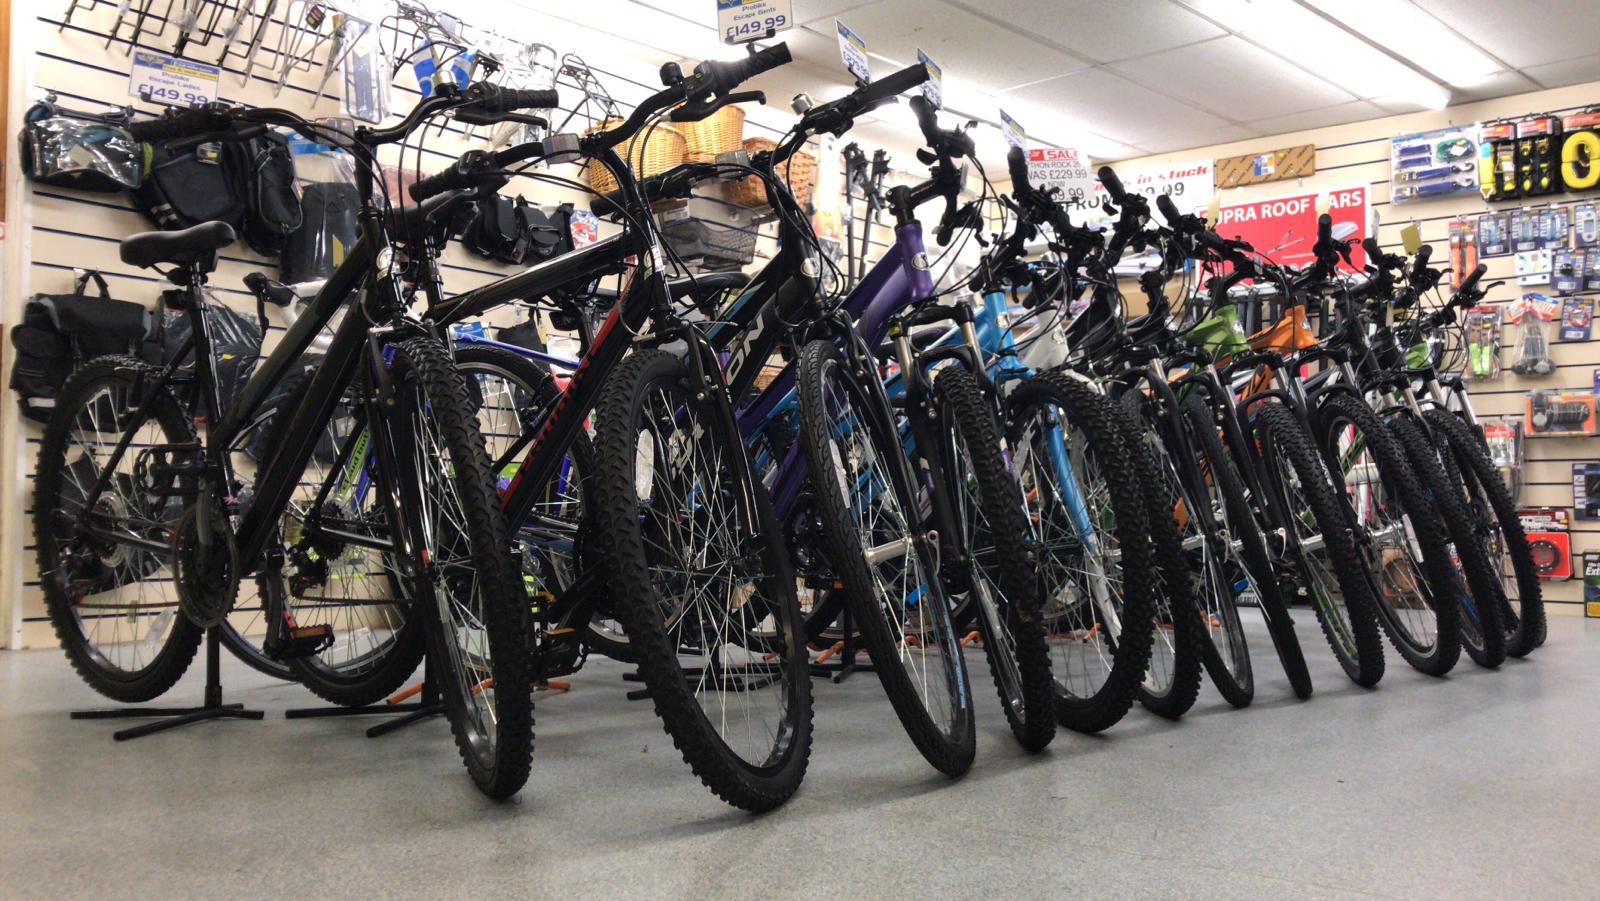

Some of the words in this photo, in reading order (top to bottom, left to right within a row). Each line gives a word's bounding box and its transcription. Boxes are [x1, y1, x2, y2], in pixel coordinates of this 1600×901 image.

[758, 7, 776, 15] Gents
[727, 15, 786, 37] £149.99
[177, 81, 202, 91] Ladies
[138, 84, 209, 105] £149.99
[1029, 162, 1050, 170] THON
[1051, 161, 1072, 169] ROCK
[1050, 169, 1088, 180] £229.99
[1137, 174, 1153, 185] in
[1158, 165, 1209, 181] stock
[1201, 204, 1258, 226] UPRA
[1261, 199, 1311, 220] ROOF
